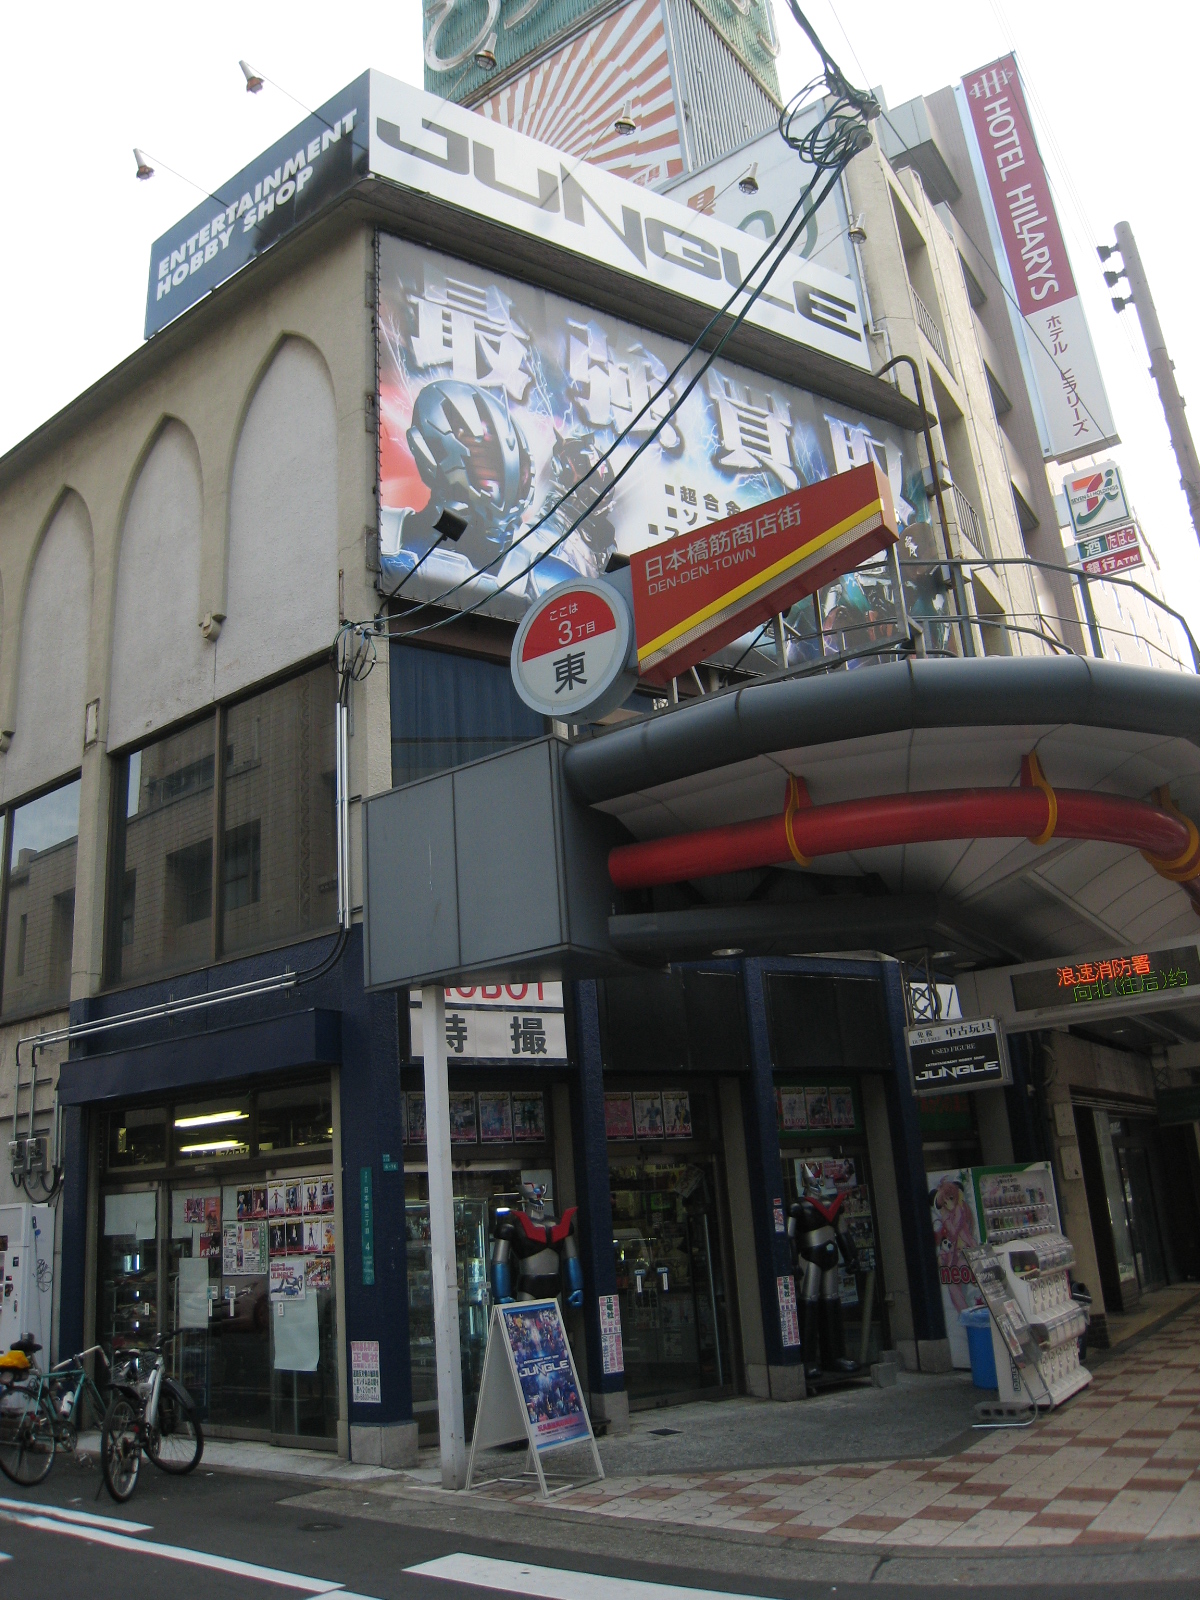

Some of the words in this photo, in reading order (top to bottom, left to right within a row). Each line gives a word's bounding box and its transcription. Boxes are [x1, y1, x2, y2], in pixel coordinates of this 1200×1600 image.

[157, 109, 359, 279] ENTERTAINMENT
[984, 97, 1026, 182] HOTEL
[1006, 183, 1060, 301] HILARYS
[155, 226, 236, 302] HOBBY
[242, 167, 314, 233] SHOP
[376, 117, 862, 343] JUNGLE
[1046, 315, 1069, 357] ホテル
[644, 502, 801, 582] 日本橋筋商店街
[1084, 538, 1101, 557] 酒
[1107, 528, 1136, 549] たばこ
[648, 546, 756, 596] DEN-DEN-TOWN
[549, 602, 578, 621] ここは
[558, 621, 596, 645] 3丁目
[552, 652, 588, 695] 東
[1056, 954, 1150, 987] 浪速消防署
[945, 1020, 992, 1038] 中古玩具
[931, 1046, 949, 1055] USED
[950, 1042, 976, 1052] FIGURE
[915, 1060, 999, 1081] JUNGLE
[519, 1359, 570, 1377] JUNGLE
